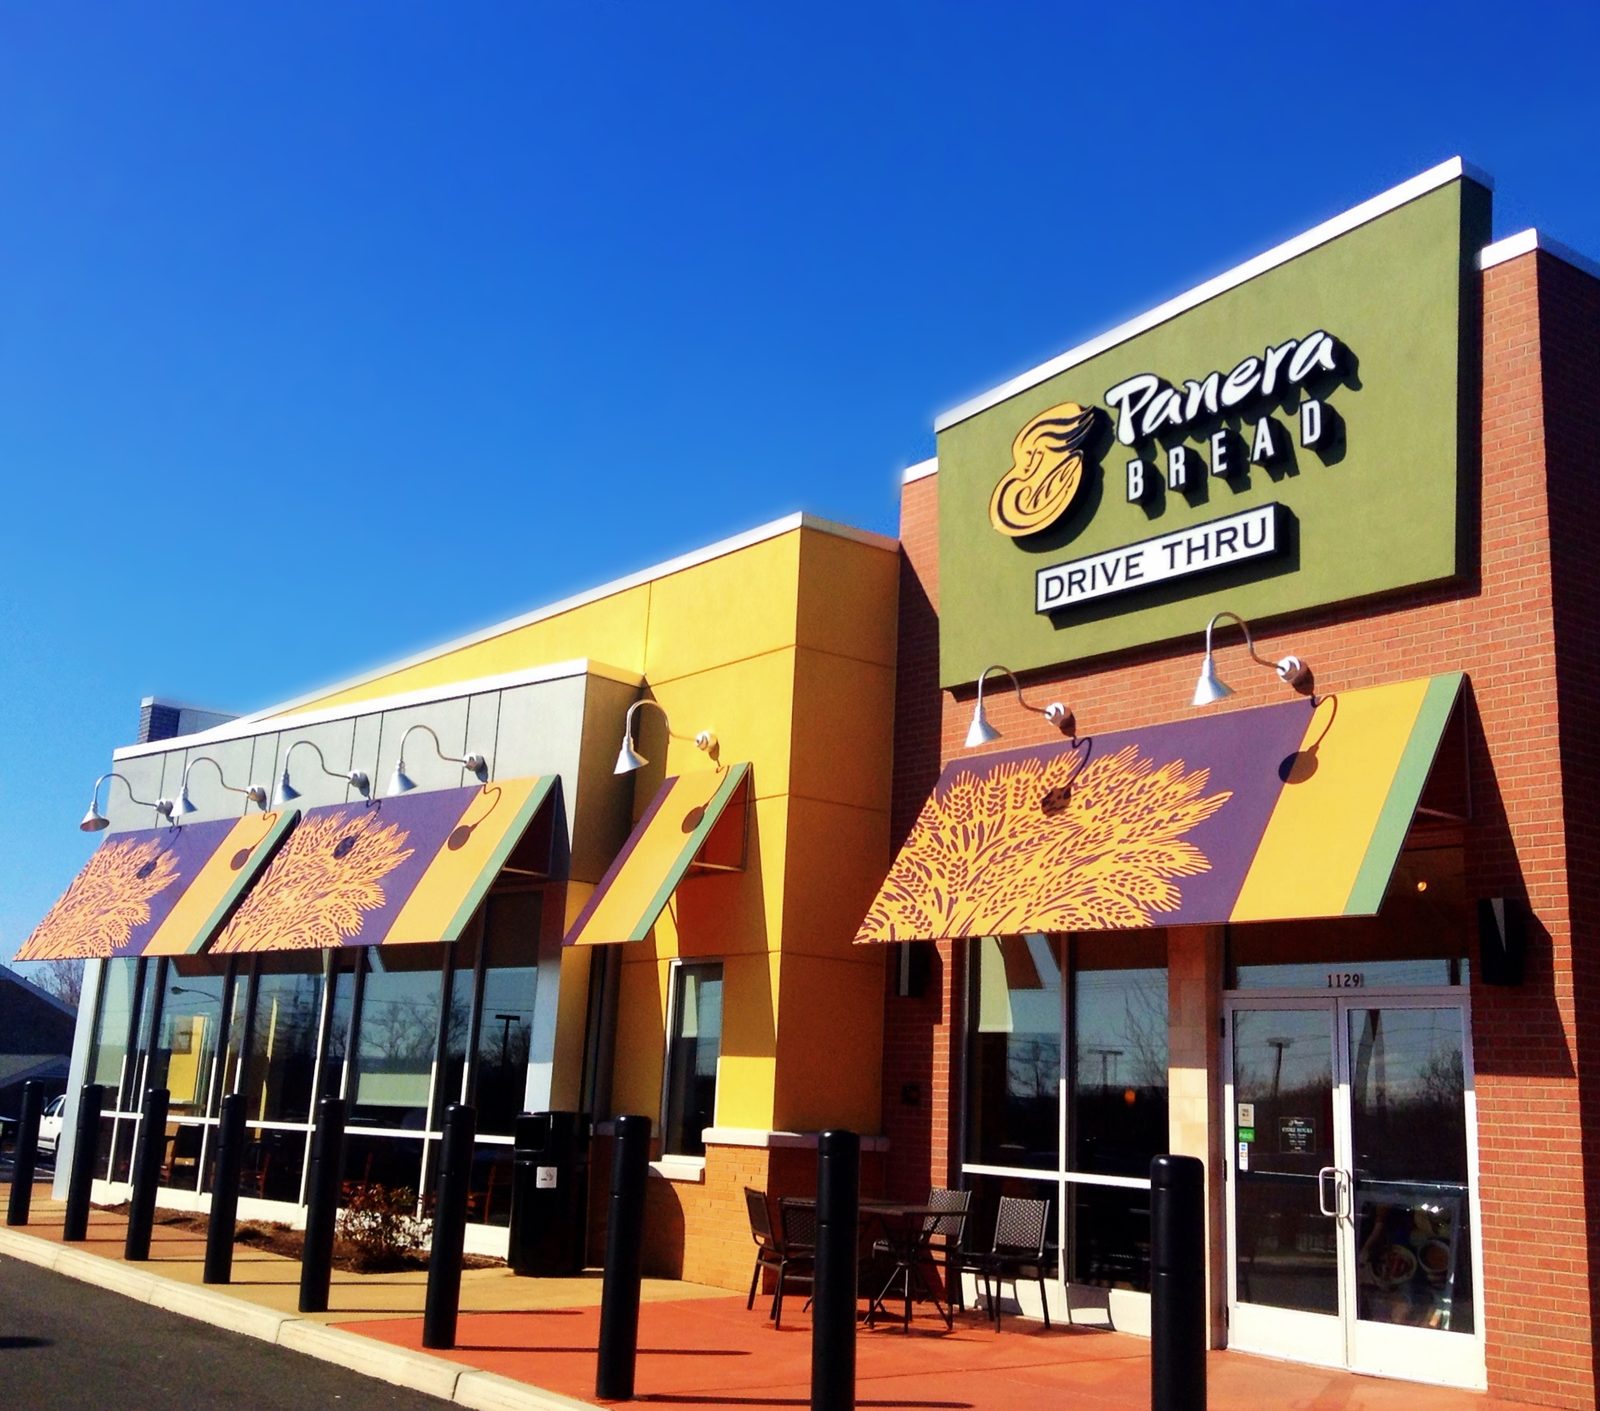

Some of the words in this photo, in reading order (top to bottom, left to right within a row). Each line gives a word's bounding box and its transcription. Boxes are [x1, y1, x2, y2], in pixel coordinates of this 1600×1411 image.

[1105, 331, 1336, 444] Panera
[1127, 400, 1321, 501] BREAD
[1044, 551, 1144, 602] DRIVE
[1162, 516, 1267, 570] THRU
[1327, 973, 1360, 988] 1129
